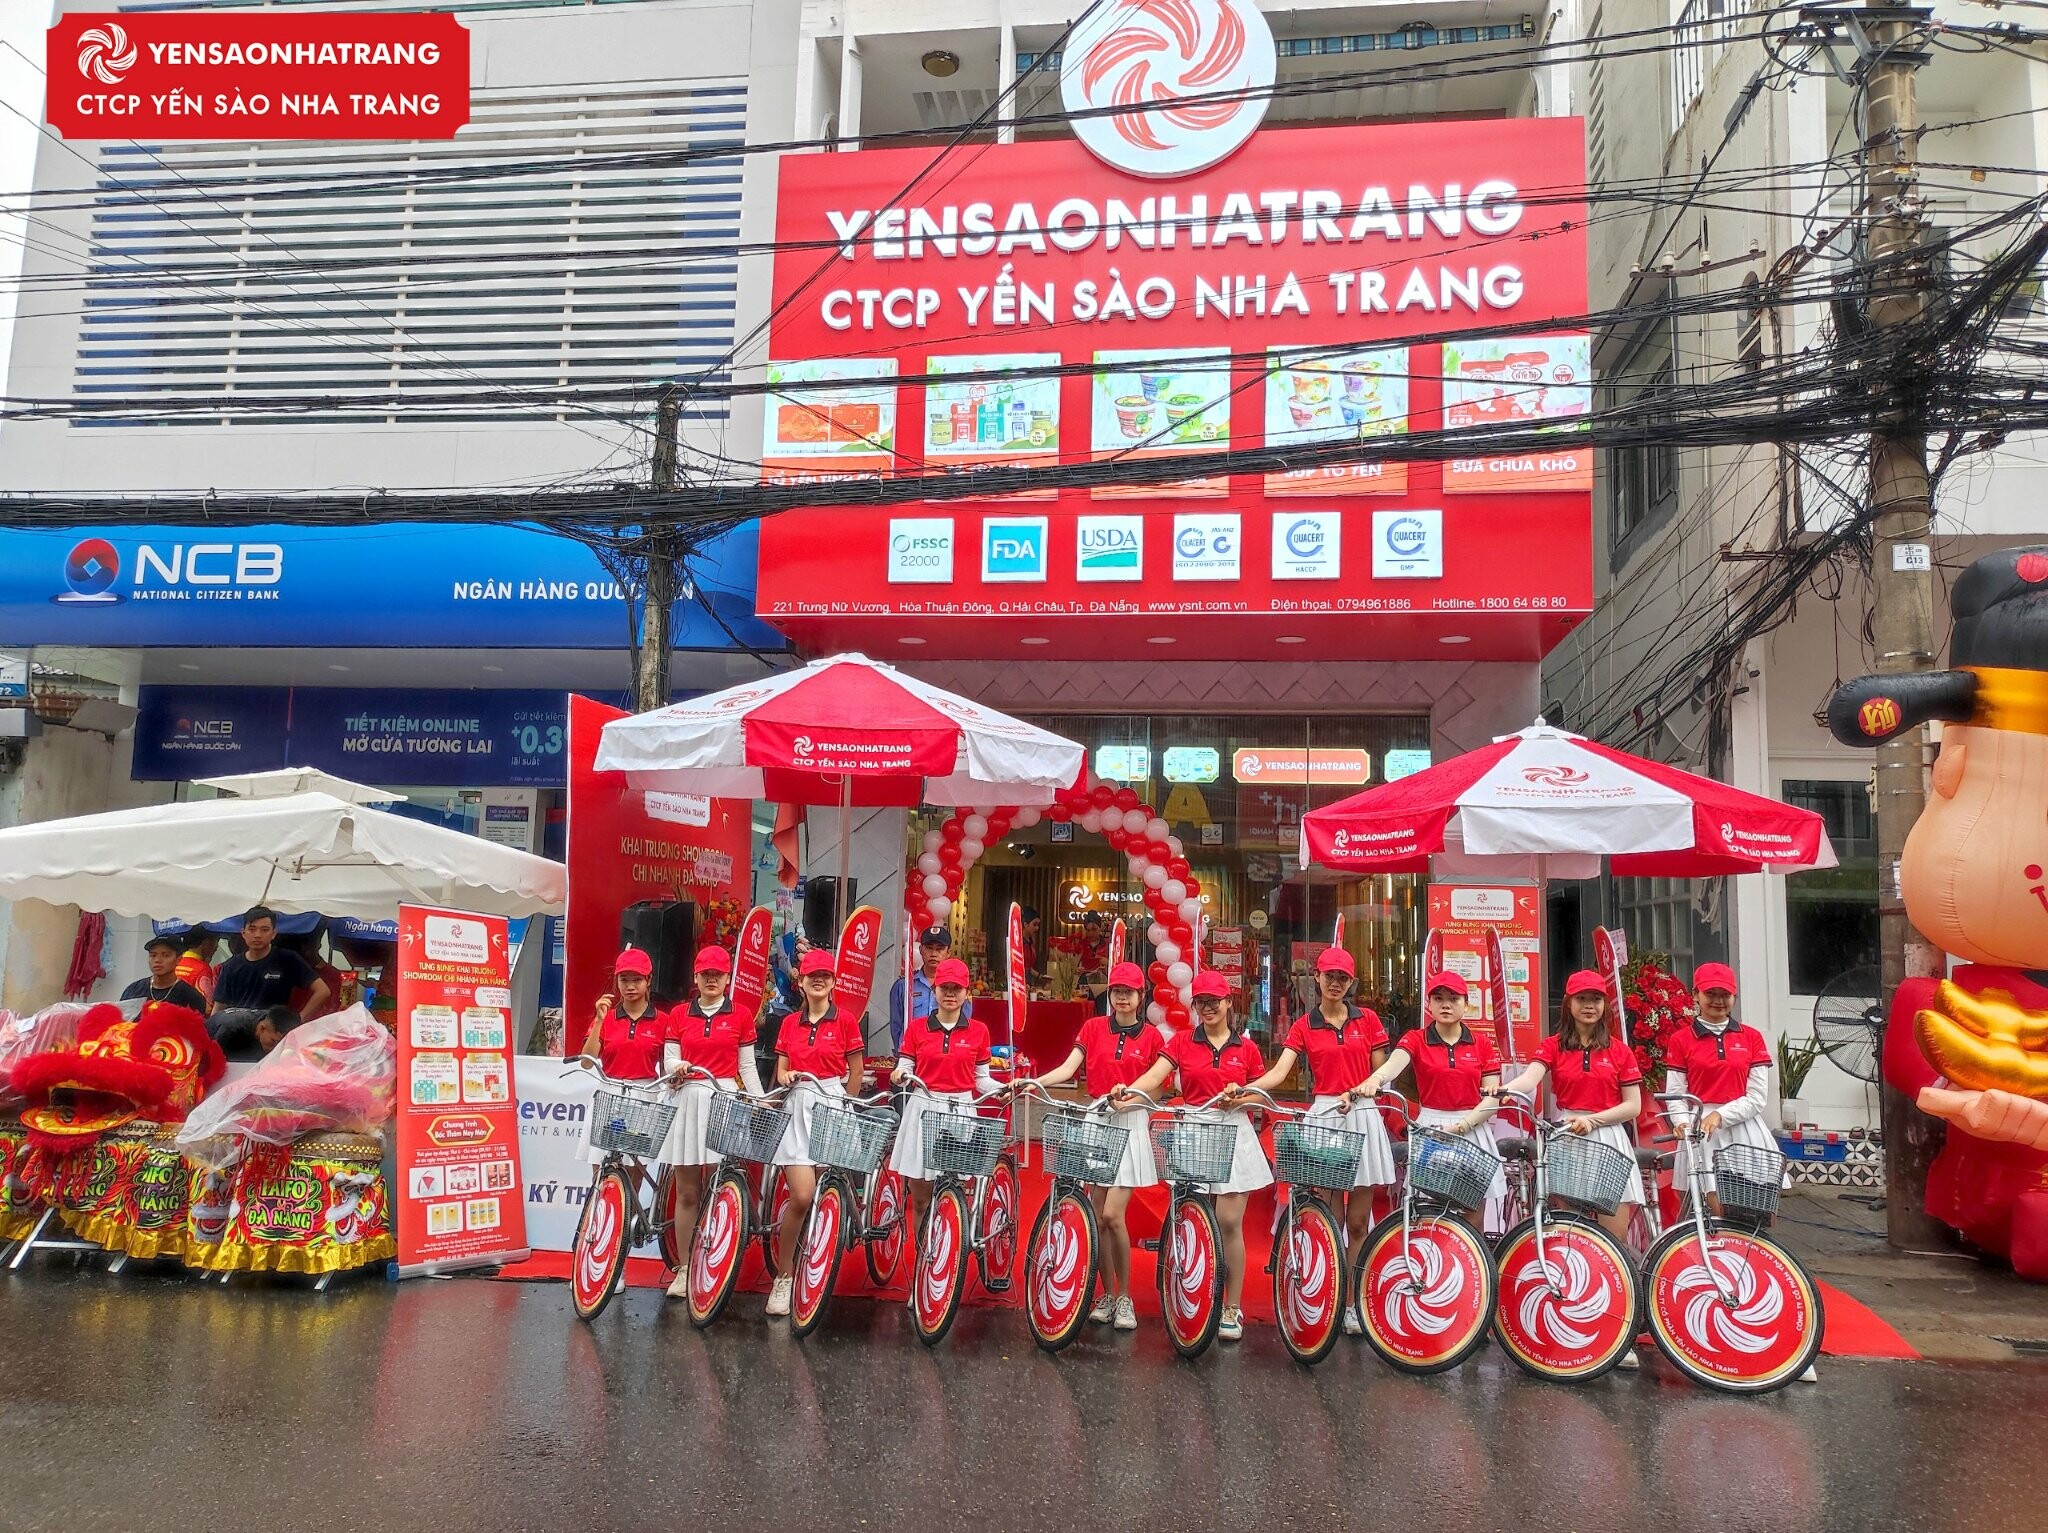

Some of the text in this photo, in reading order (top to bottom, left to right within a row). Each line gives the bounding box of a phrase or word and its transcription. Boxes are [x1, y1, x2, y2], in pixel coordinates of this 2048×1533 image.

[826, 180, 1524, 261] YENSAONHATRANG
[821, 262, 1524, 330] CTCP YẾN SÀO NHA TRANG
[1489, 456, 1577, 472] CHUA KHÔ
[912, 538, 949, 549] FSSC
[1082, 529, 1138, 547] USDA
[1293, 533, 1324, 543] QUACERT
[1394, 531, 1427, 542] QUACERT
[992, 540, 1036, 559] FDA
[134, 544, 284, 585] NCB
[900, 556, 940, 566] 22000
[1906, 556, 1924, 564] C13
[133, 590, 280, 600] NATIONAL CITIZEN BANK
[454, 578, 513, 600] NGÂN
[520, 578, 579, 600] HÀNG
[773, 602, 793, 612] 221
[797, 602, 828, 614] Trưng
[832, 602, 849, 612] Nữ
[852, 602, 891, 615] Vương,
[900, 602, 922, 612] Hòa
[925, 602, 959, 614] Thuận
[962, 602, 995, 614] Đông,
[1034, 601, 1066, 613] Châu,
[1068, 601, 1085, 614] Tp.
[1090, 600, 1106, 612] Đà
[1110, 600, 1139, 613] Nẵng
[1271, 599, 1299, 611] Điện
[1337, 598, 1411, 610] 0794961886
[1432, 598, 1477, 609] Hotline:
[1480, 598, 1510, 608] 1800
[1512, 598, 1529, 608] 64
[1532, 597, 1548, 608] 68
[1551, 597, 1567, 607] 80
[194, 721, 233, 734] NCB
[345, 712, 480, 736] TIẾT KIỆM ONLINE
[342, 734, 493, 754] MỞ CỬA TƯƠNG LAI
[817, 743, 912, 753] YENSAONHATRANG
[793, 757, 911, 769] CTCP YẾN SÀO NHA TRANG
[1264, 762, 1362, 771] YENSAONHATRANG
[1351, 828, 1415, 842] YENSAONHATRANG
[1735, 830, 1792, 843] YENSAONHATRANG
[621, 836, 643, 854] KHAI
[632, 864, 648, 882] CHI
[370, 922, 393, 936] hàng
[403, 971, 443, 982] SHOWROOM
[552, 1126, 560, 1136] &
[528, 1180, 559, 1203] KỸ
[1559, 1359, 1573, 1367] NHA
[1572, 1354, 1594, 1366] TRANG
[1699, 1357, 1714, 1369] NHA
[1715, 1364, 1739, 1374] TRANG
